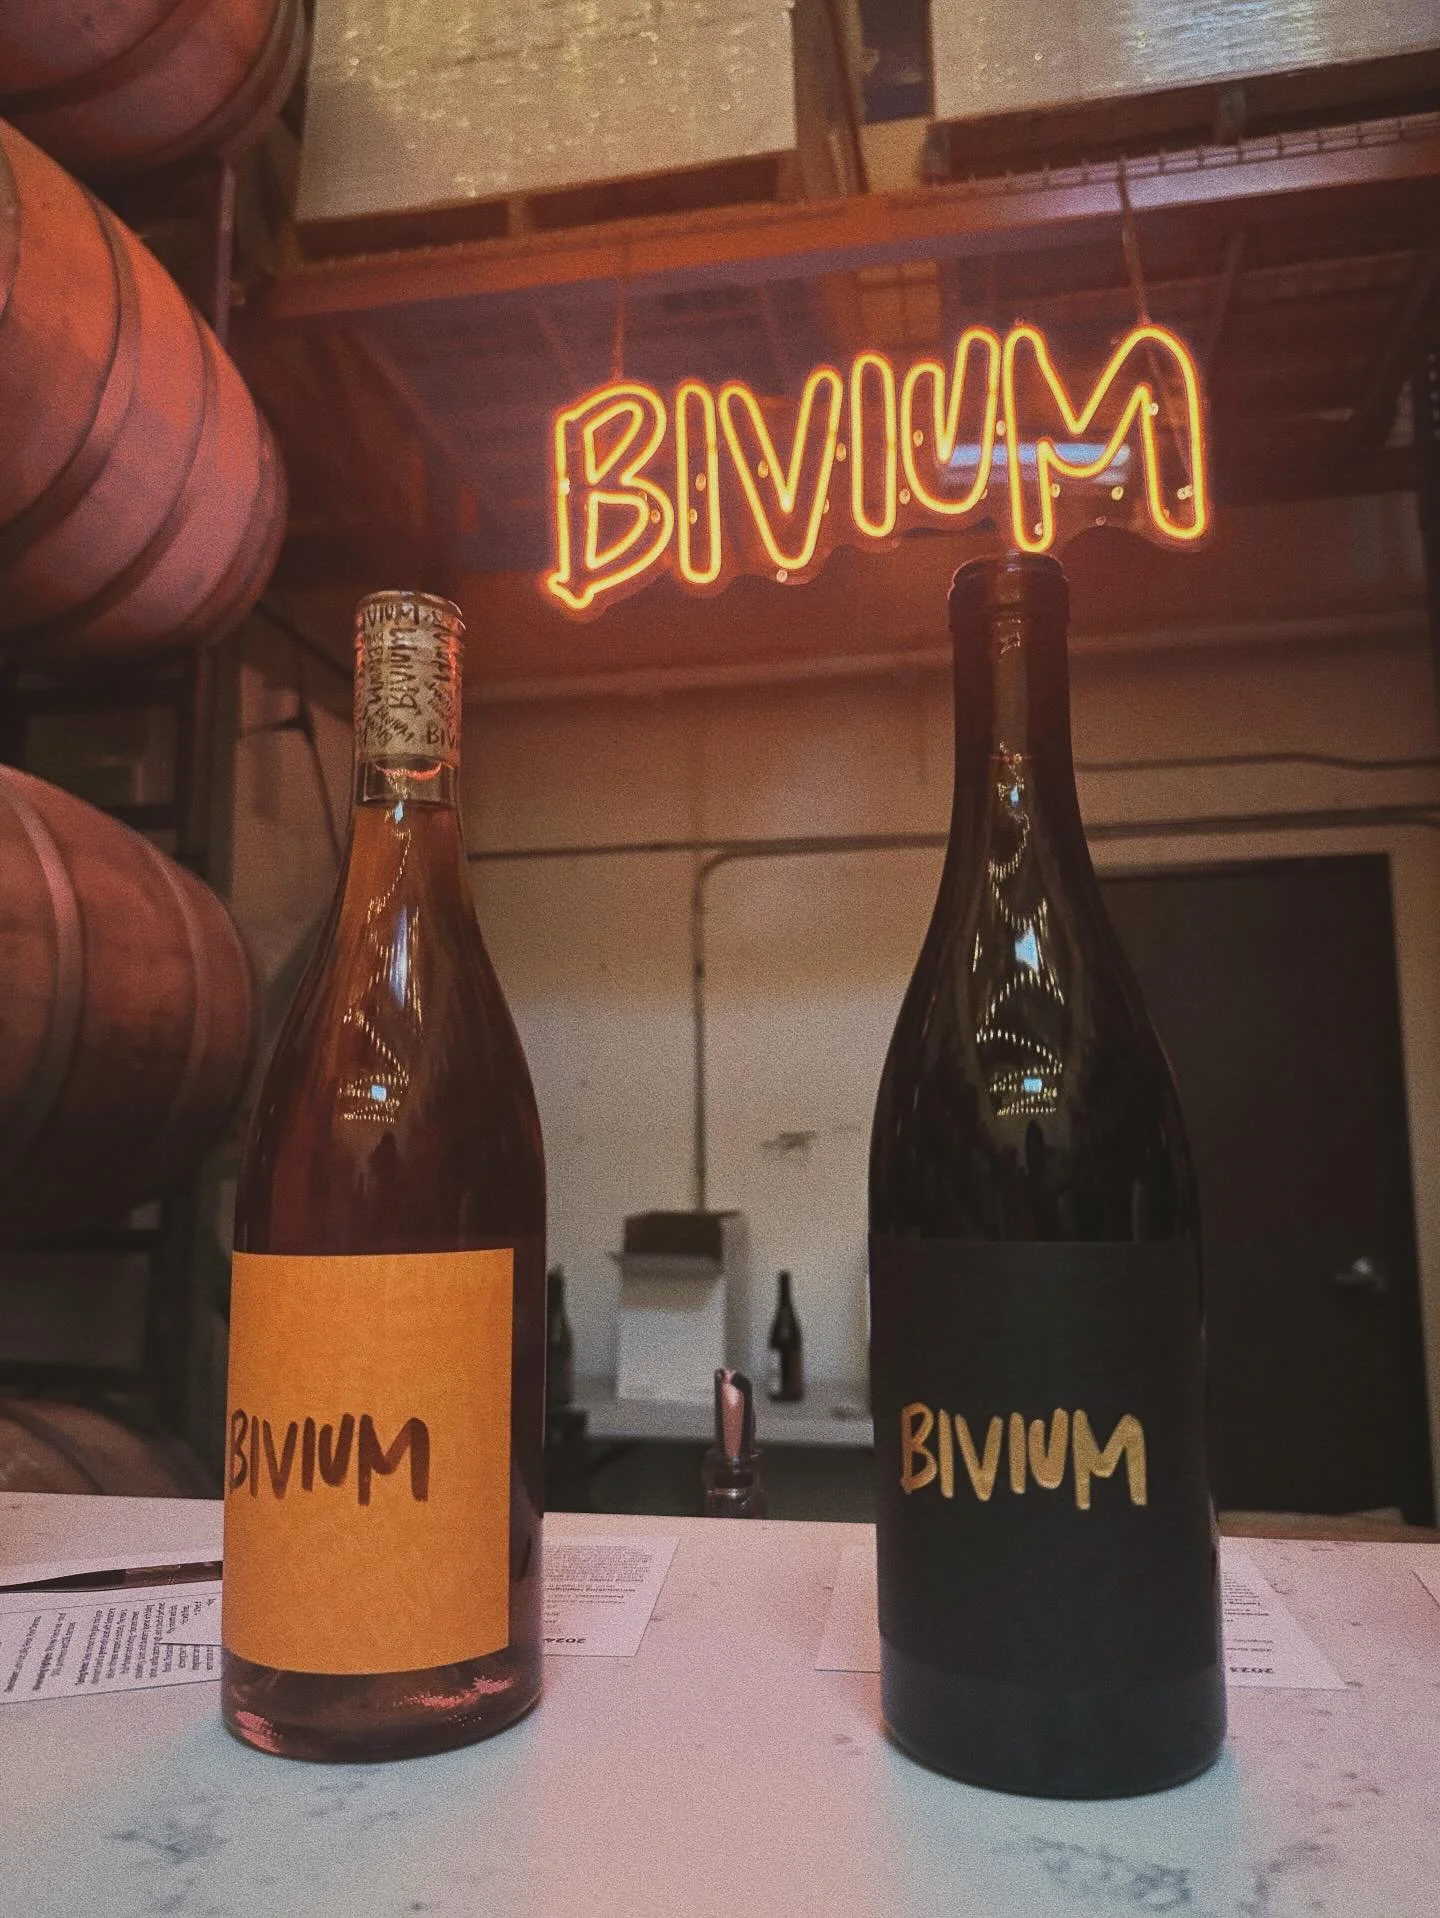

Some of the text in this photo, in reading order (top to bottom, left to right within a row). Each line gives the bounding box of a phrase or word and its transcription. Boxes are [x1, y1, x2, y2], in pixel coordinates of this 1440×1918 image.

[545, 323, 1208, 611] BIVIUM
[229, 1408, 430, 1506] BIVIUM
[900, 1402, 1147, 1510] BIVIUM
